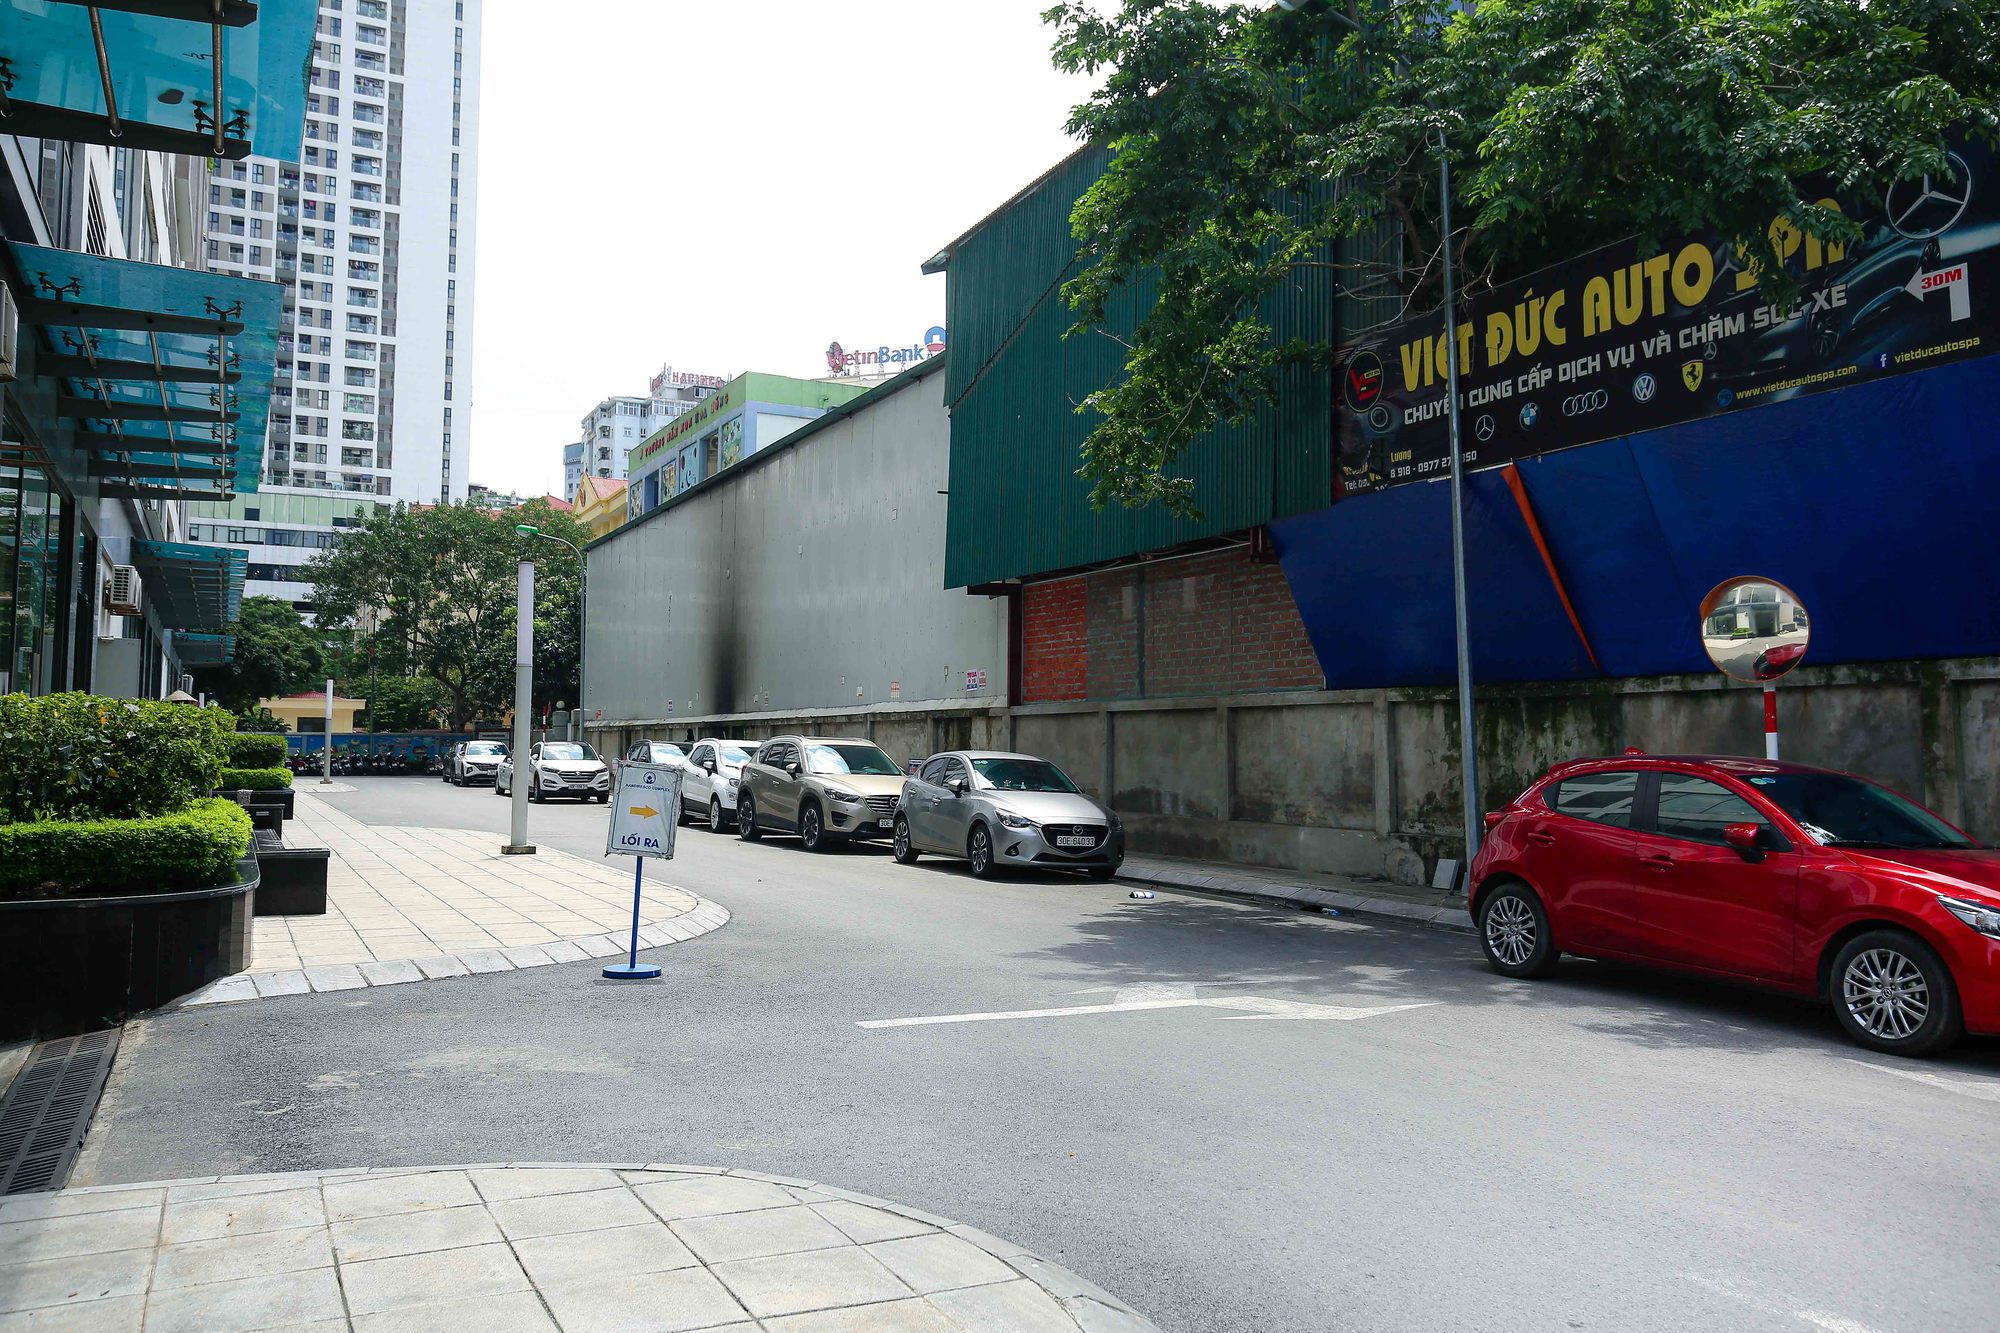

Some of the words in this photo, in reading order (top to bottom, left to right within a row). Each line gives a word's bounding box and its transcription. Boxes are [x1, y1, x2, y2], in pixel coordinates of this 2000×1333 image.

[1920, 267, 1962, 290] 30M
[1486, 288, 1567, 369] ĐỨC
[1582, 242, 1715, 338] AUTO
[1469, 377, 1512, 407] CUNG
[1518, 362, 1552, 393] CẤP
[1559, 355, 1600, 382] DỊCH
[1607, 343, 1635, 370] VỤ
[1641, 329, 1671, 359] VÀ
[1679, 312, 1745, 349] CHĂM
[1811, 283, 1847, 314] XE
[1894, 334, 1981, 364] vietducautospa
[1735, 363, 1858, 401] www.vietducautospa.com
[621, 832, 641, 846] LỐI
[644, 837, 660, 849] RA
